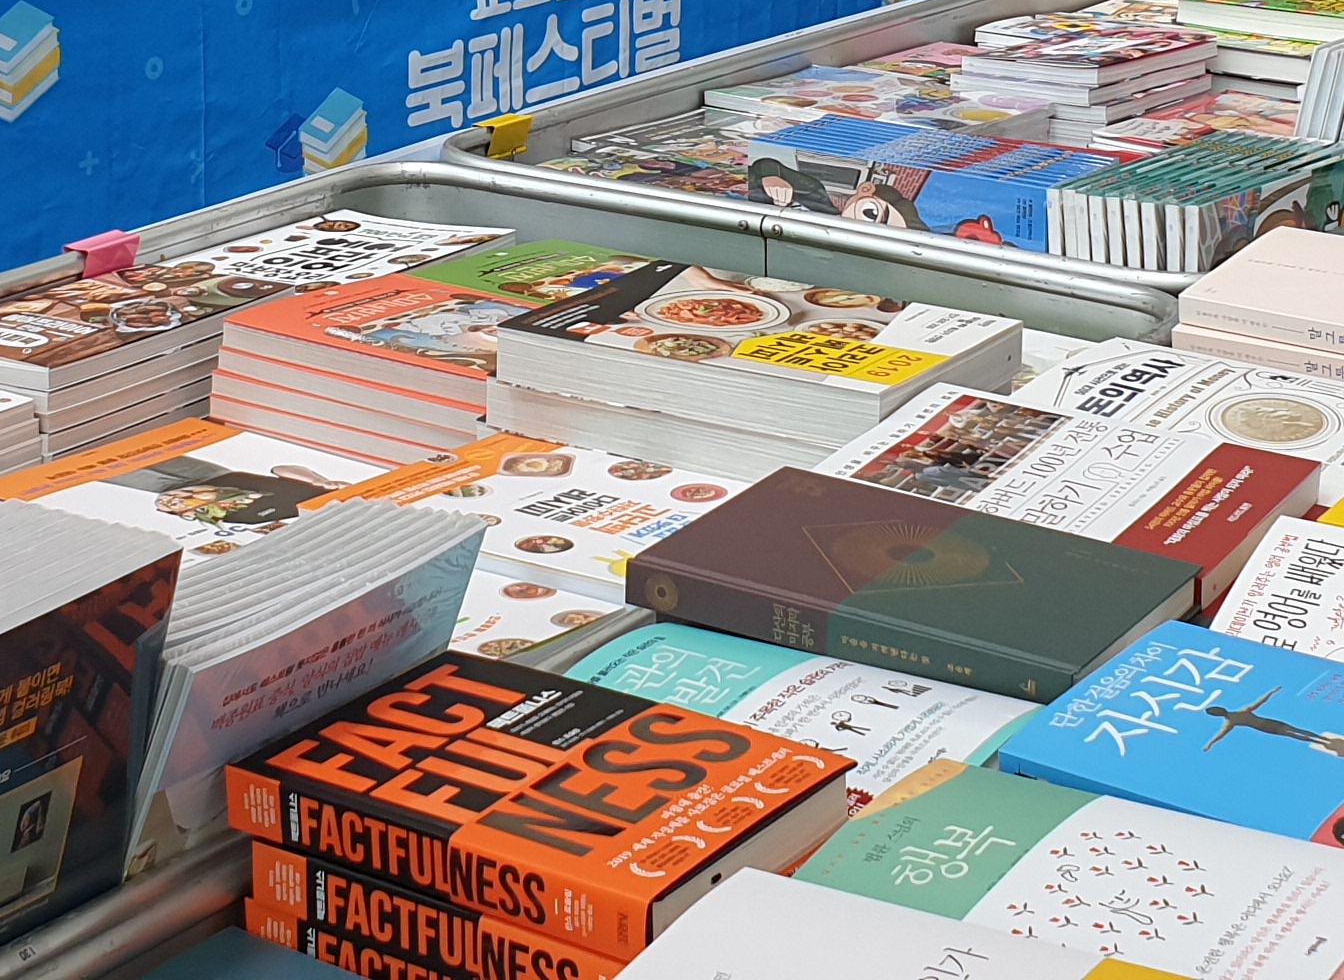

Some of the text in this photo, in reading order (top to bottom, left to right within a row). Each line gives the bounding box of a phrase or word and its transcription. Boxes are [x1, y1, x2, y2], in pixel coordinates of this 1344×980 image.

[738, 329, 815, 361] 레시피
[774, 339, 850, 366] 베스트
[808, 343, 884, 373] 코리아
[865, 354, 923, 377] 2019
[1076, 357, 1184, 418] 돈의 역사
[1152, 368, 1235, 419] History of Money
[834, 459, 863, 476] 인생을
[862, 441, 889, 456] 바꾸는
[888, 422, 915, 439] 말하기
[914, 403, 940, 420] 불변의
[977, 419, 1109, 517] 하버드 100년 전통
[1020, 479, 1102, 531] 말하기
[1101, 428, 1160, 461] 수업
[514, 488, 596, 519] 레시피
[544, 492, 620, 526] 다이어트
[1252, 588, 1322, 631] 영어를
[1129, 641, 1177, 667] 차이
[16, 661, 61, 699] 붙이면
[665, 657, 759, 715] 발견
[1086, 647, 1252, 755] 자신감
[271, 665, 520, 791] FACT
[486, 690, 562, 729] 팩트풀니스
[374, 712, 587, 823] FUL
[482, 708, 748, 855] NESS
[886, 816, 920, 840] 스님의
[300, 795, 548, 926] FACTFULNESS
[606, 850, 633, 869] 2019
[891, 825, 1015, 885] 행복
[325, 868, 581, 980] FACTFULNESS
